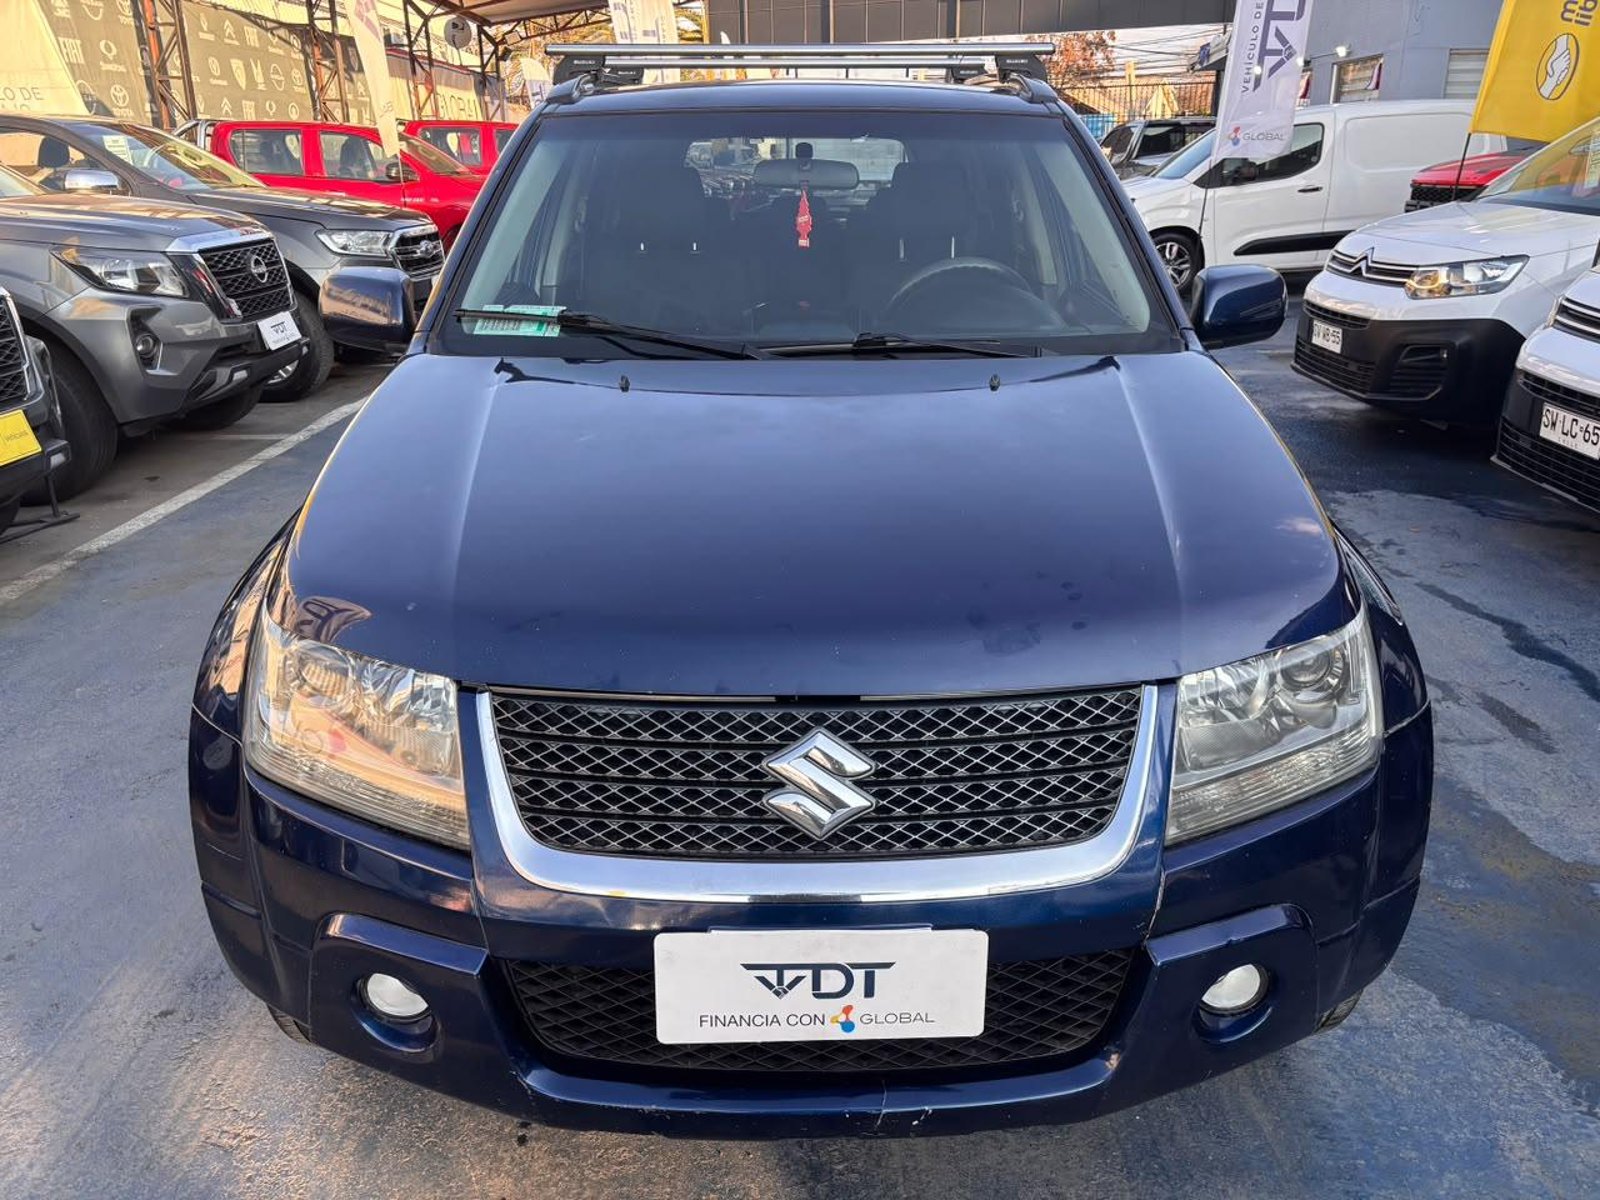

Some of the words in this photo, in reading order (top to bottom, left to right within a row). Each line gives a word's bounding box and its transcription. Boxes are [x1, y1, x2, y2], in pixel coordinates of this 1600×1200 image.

[1254, 2, 1265, 20] DE
[1242, 131, 1285, 141] GLOBAL
[699, 1014, 781, 1028] FINANCIA
[786, 1014, 825, 1026] CON
[859, 1012, 935, 1025] GLOBAL
